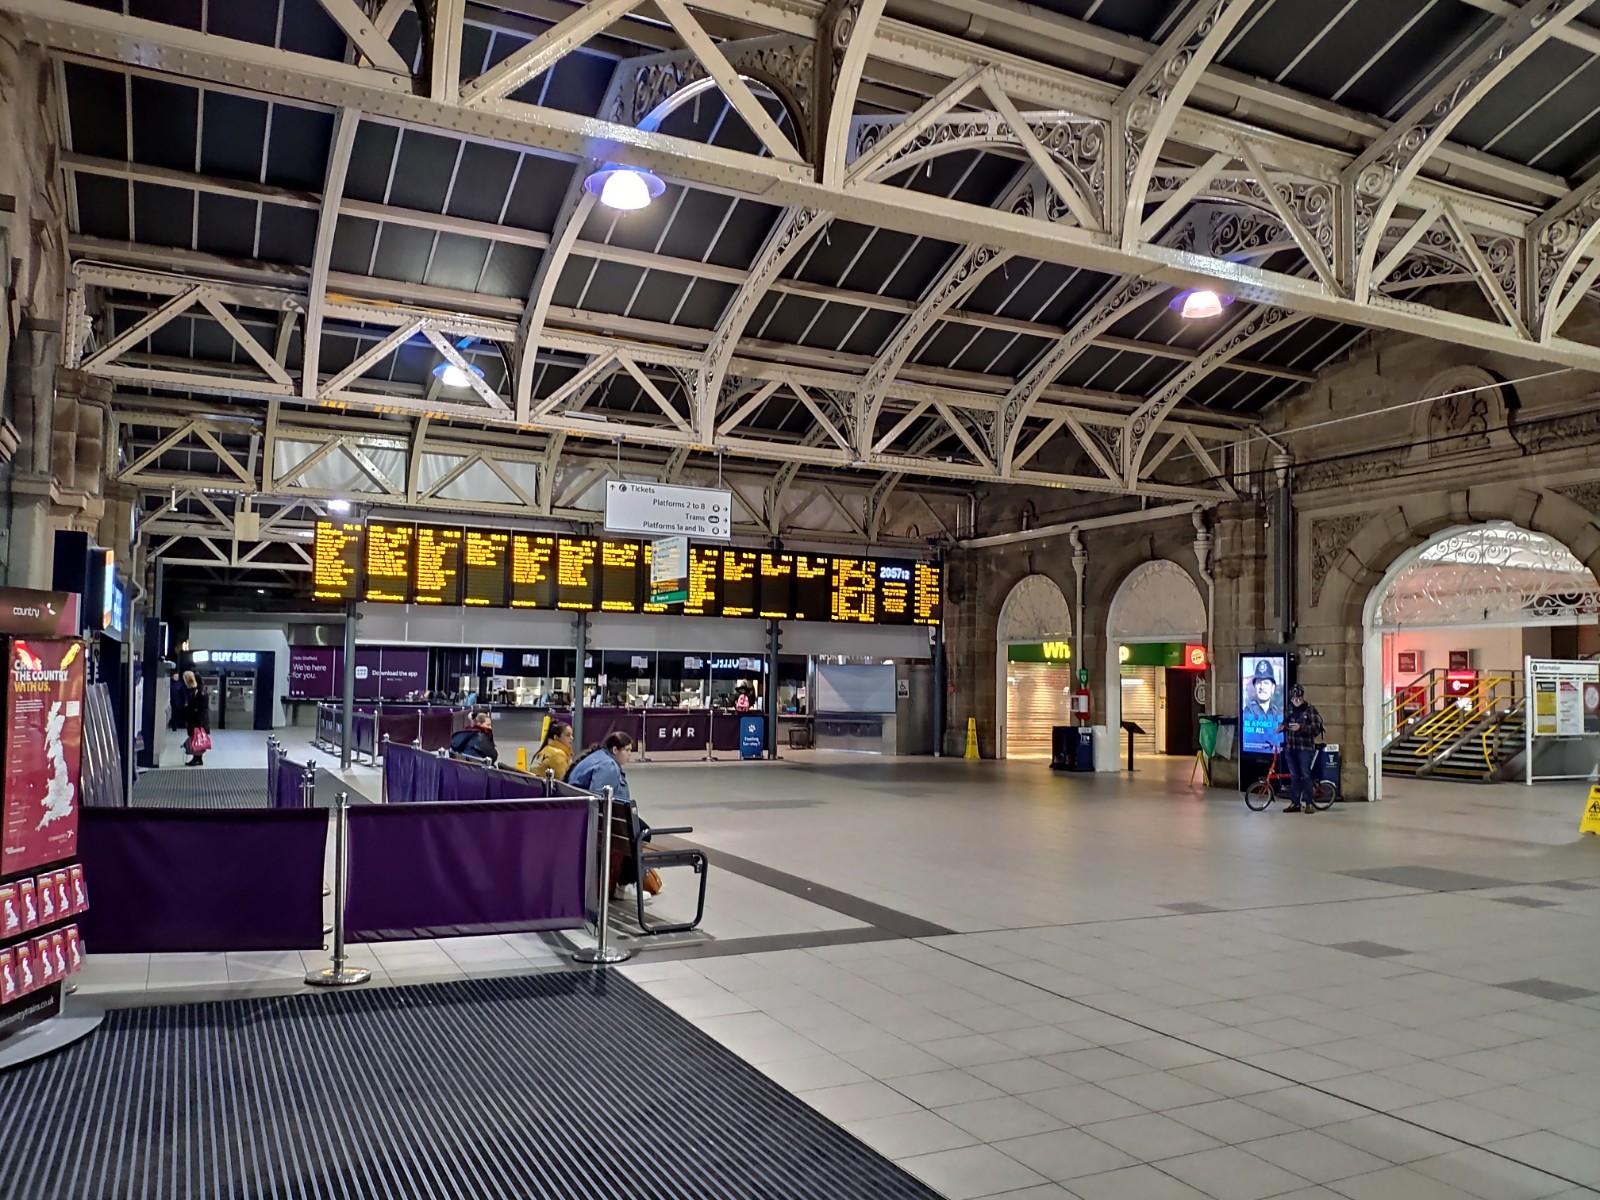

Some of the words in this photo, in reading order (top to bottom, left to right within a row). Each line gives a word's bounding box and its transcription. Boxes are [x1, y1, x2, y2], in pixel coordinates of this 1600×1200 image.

[630, 485, 655, 494] Tickets
[653, 498, 684, 508] Platforms
[686, 513, 706, 522] Trams
[643, 521, 676, 530] Platforms
[880, 566, 902, 580] 2057
[902, 570, 910, 580] 12
[13, 607, 40, 618] country
[212, 652, 232, 662] BUY
[232, 652, 256, 662] HERE
[14, 670, 31, 681] THE
[32, 670, 68, 682] COUNTRY
[14, 682, 37, 692] WITH
[38, 682, 51, 692] US.
[658, 727, 695, 738] EMR
